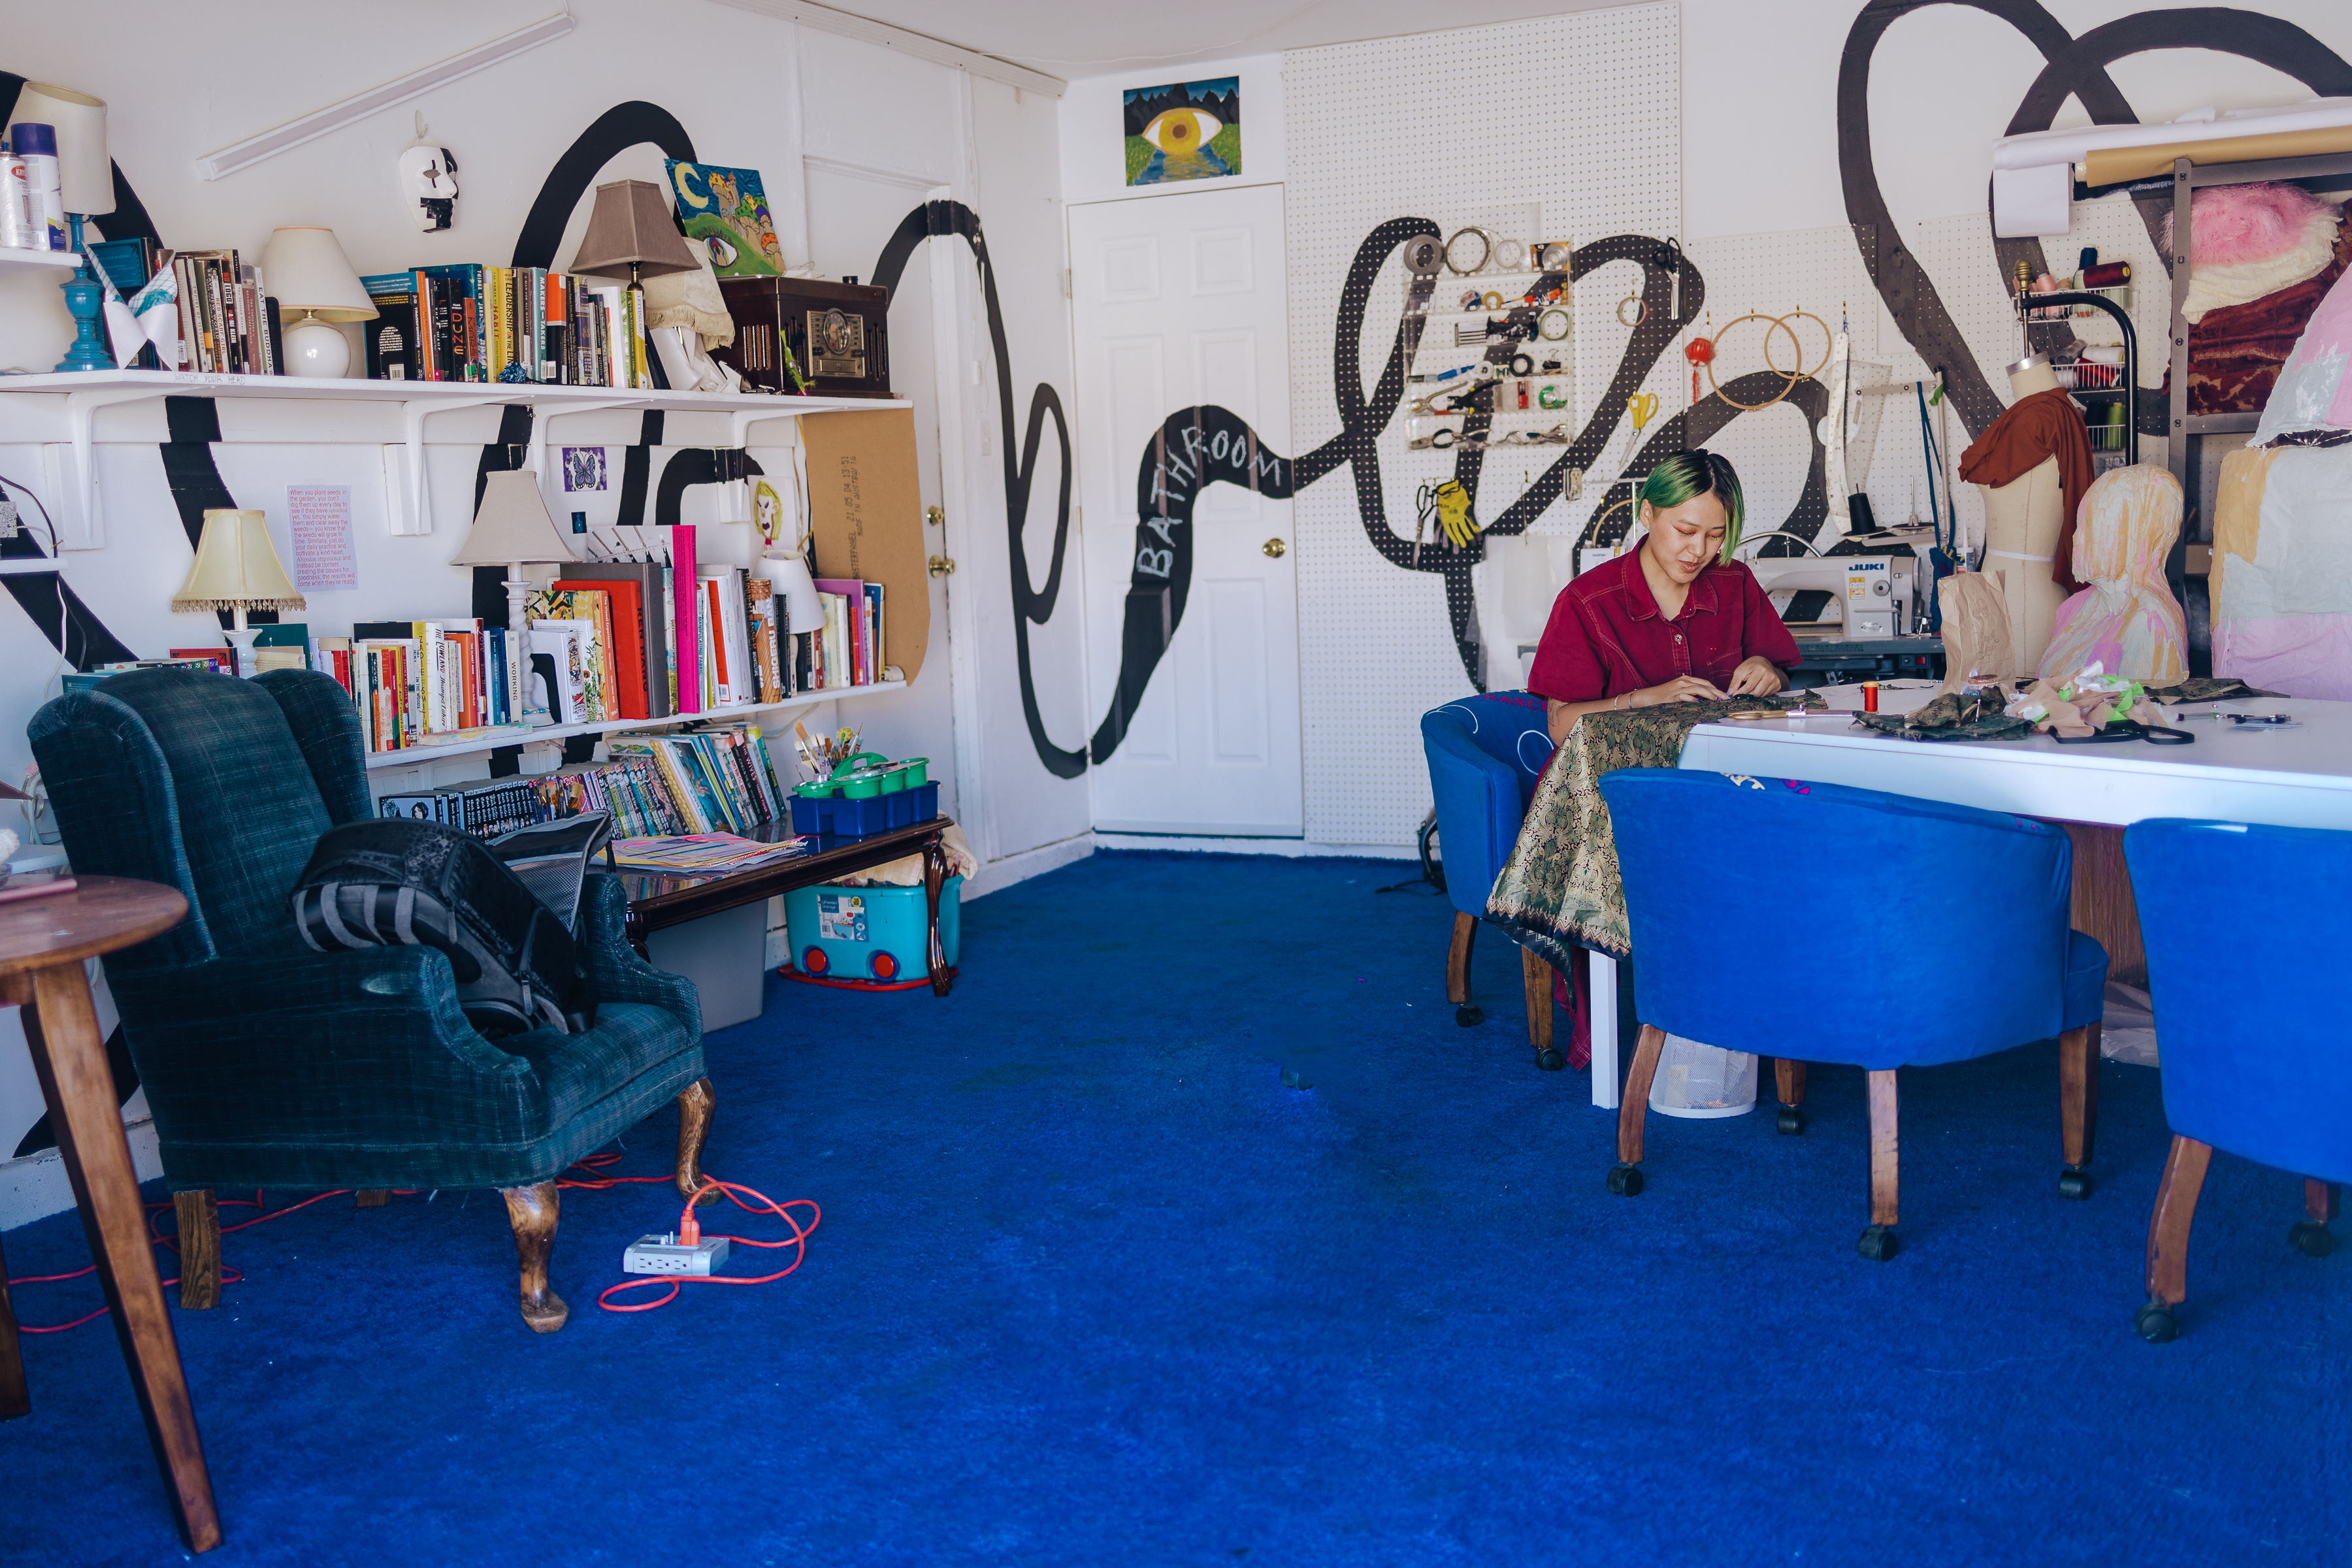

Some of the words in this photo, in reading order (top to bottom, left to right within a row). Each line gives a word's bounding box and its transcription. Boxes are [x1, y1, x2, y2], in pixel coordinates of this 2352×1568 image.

[638, 323, 642, 333] GO
[263, 329, 272, 368] BUDDHA
[174, 374, 198, 382] WATCH
[204, 375, 223, 384] YOUR
[229, 376, 246, 385] HEAD
[1137, 427, 1283, 578] BATHROOM
[742, 573, 756, 649] HUNDERTWASSER
[765, 599, 774, 627] BAN
[1972, 630, 1999, 646] Thank
[436, 641, 446, 673] LOWLAND
[639, 646, 648, 692] HANG
[768, 630, 779, 689] SHIGERU
[437, 675, 446, 704] Jhumpa
[745, 756, 757, 781] WIVES
